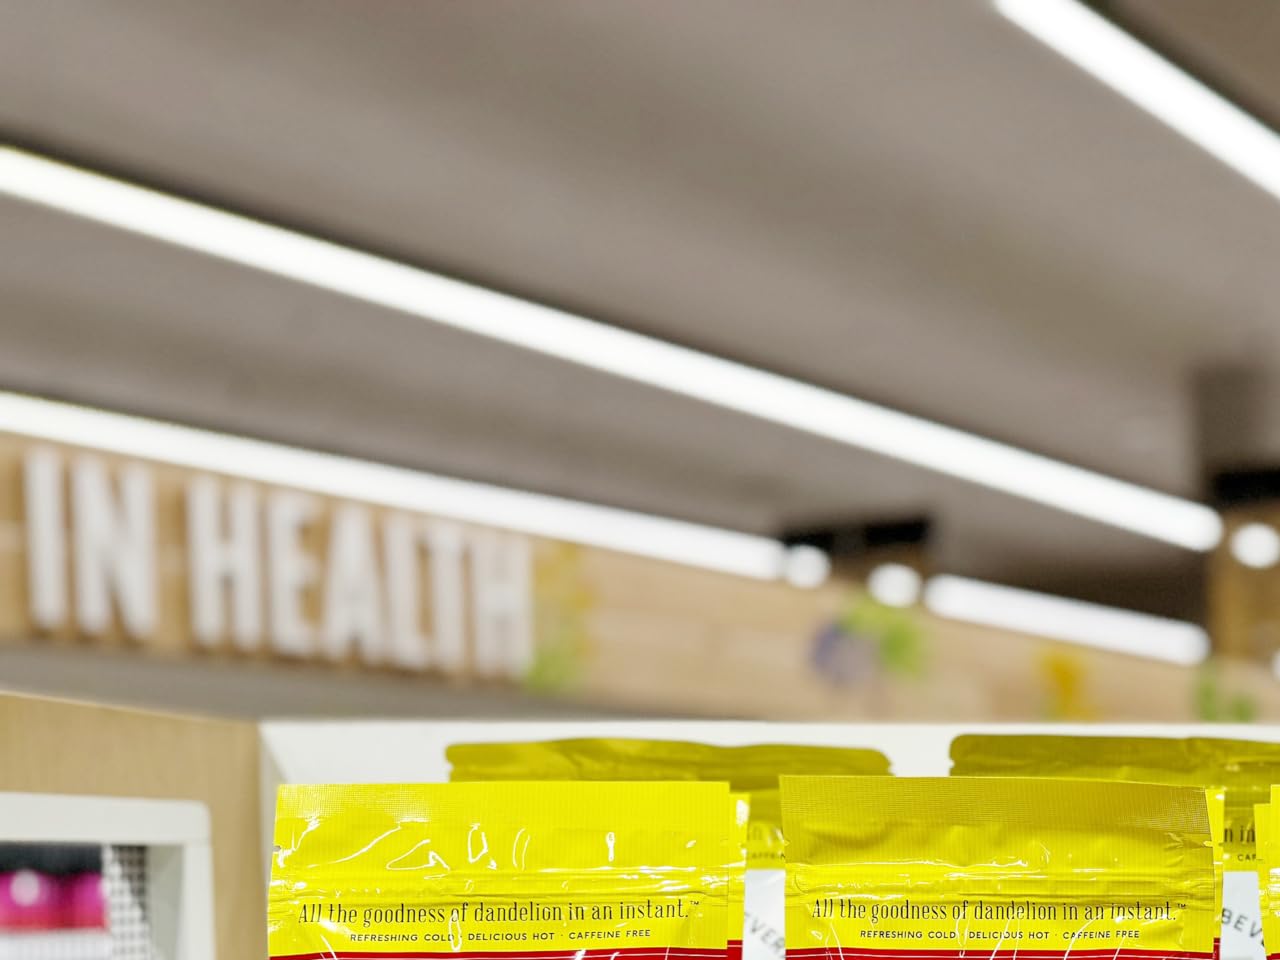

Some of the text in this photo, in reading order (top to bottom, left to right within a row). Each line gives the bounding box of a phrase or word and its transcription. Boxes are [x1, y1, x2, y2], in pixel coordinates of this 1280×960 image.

[26, 449, 533, 676] IN HEALTH
[299, 904, 322, 923] All
[328, 904, 357, 923] the
[364, 904, 445, 928] goodness
[452, 903, 469, 922] of
[474, 901, 562, 922] dandelion
[569, 903, 584, 921] in
[592, 905, 612, 920] an
[813, 899, 833, 917] All
[840, 899, 866, 918] the
[871, 900, 946, 923] goodness
[952, 900, 968, 920] of
[974, 901, 1056, 920] dandelion
[1064, 903, 1078, 920] in
[1085, 906, 1104, 920] an
[468, 933, 527, 941] DELICIOUS
[569, 931, 620, 939] CAFFEINE
[969, 931, 1023, 939] DELICIOUS
[1063, 931, 1110, 939] CAFFEINE
